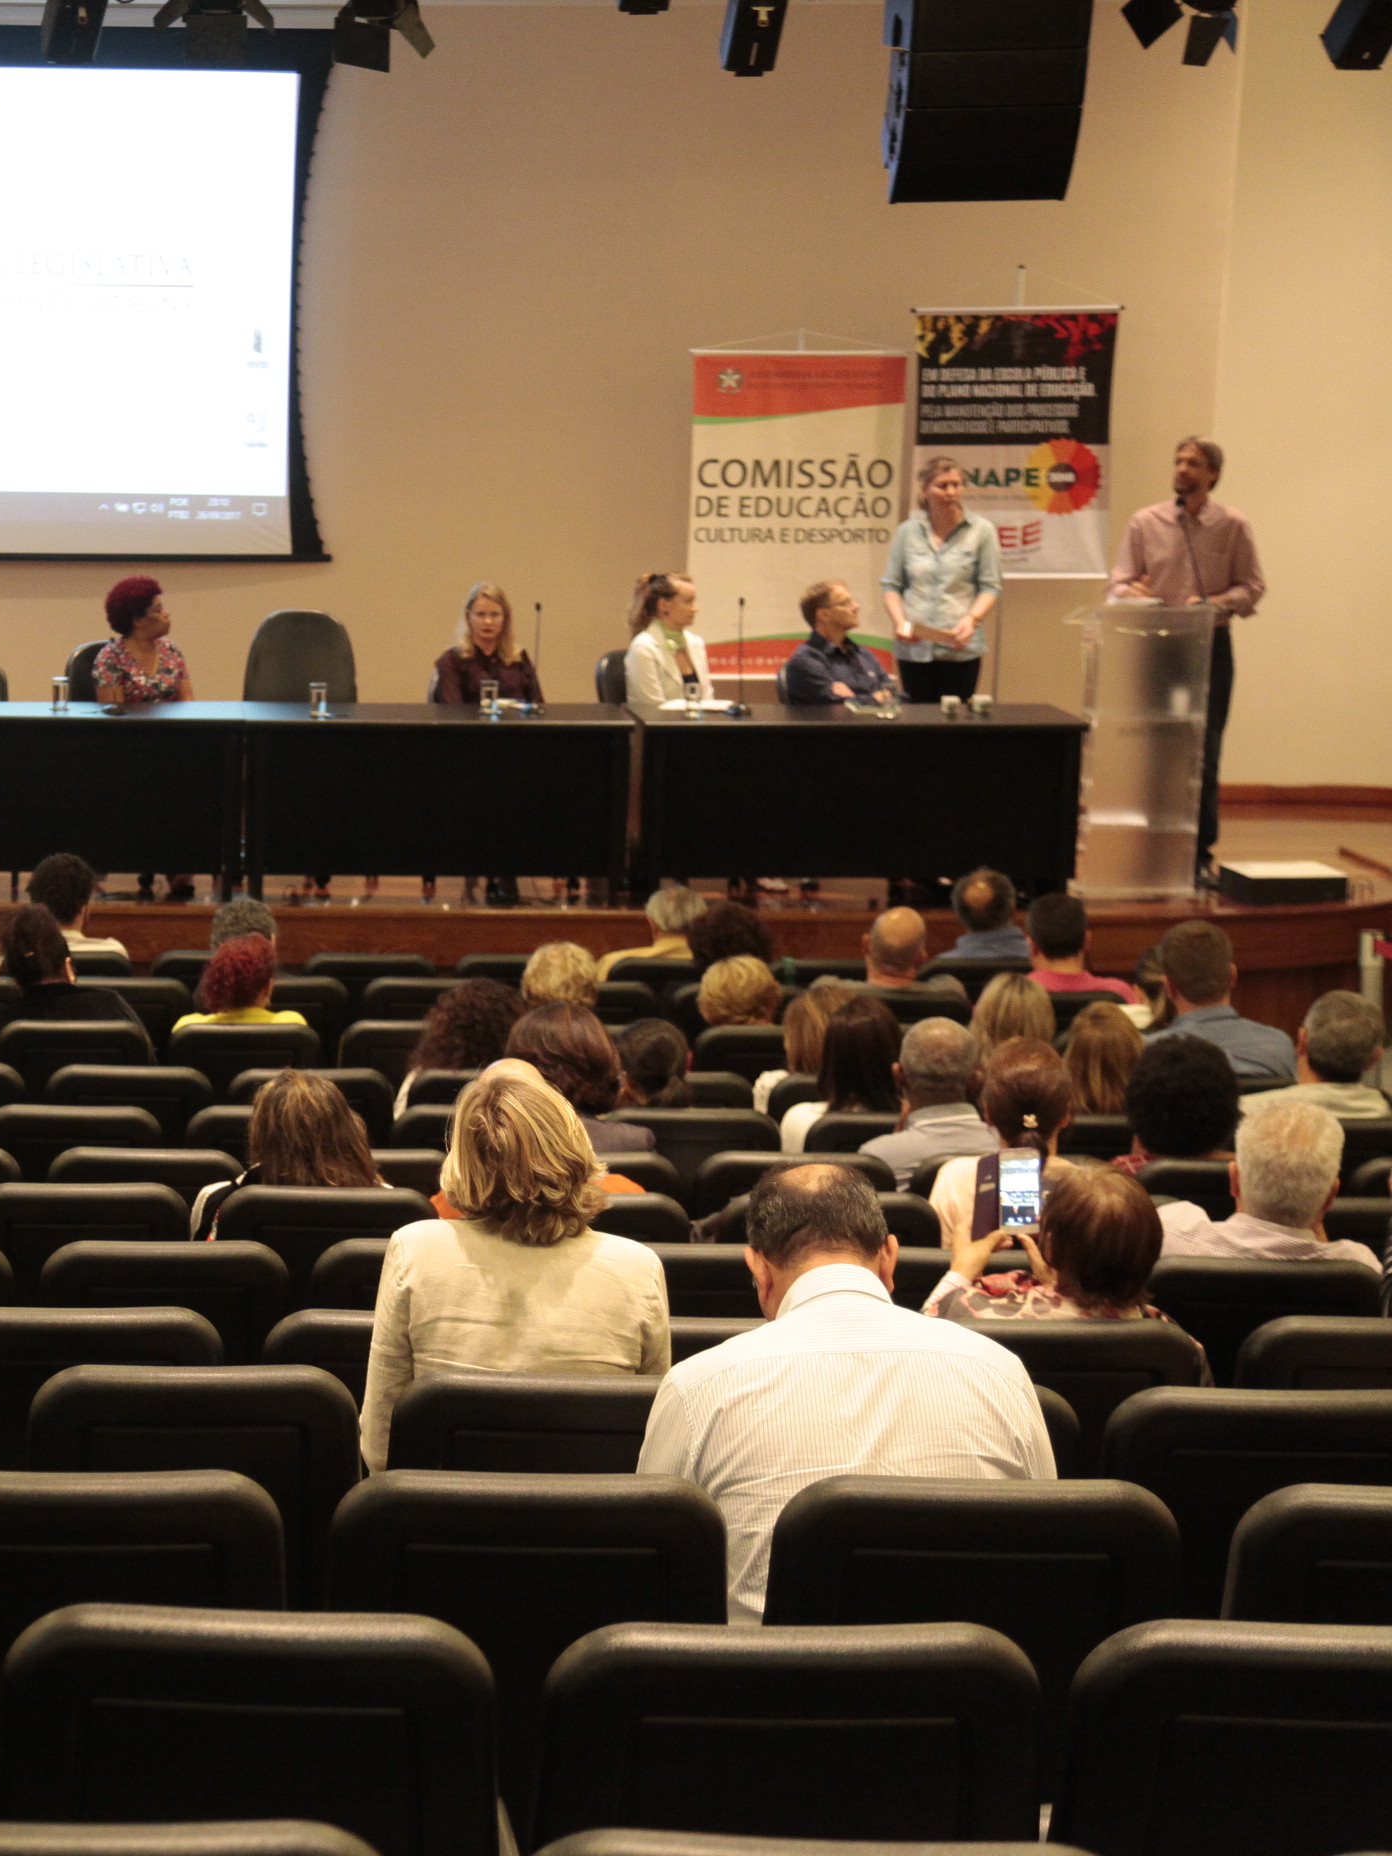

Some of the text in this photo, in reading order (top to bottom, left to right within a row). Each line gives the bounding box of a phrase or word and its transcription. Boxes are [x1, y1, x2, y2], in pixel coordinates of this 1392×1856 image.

[15, 253, 193, 277] LEGISLATIVA
[697, 453, 894, 489] COMISSÃO
[963, 467, 1041, 487] NAPE
[694, 491, 893, 525] DE EDUCAÇÃO
[694, 527, 892, 545] CULTURA E DESPORTO
[999, 519, 1042, 547] EE
